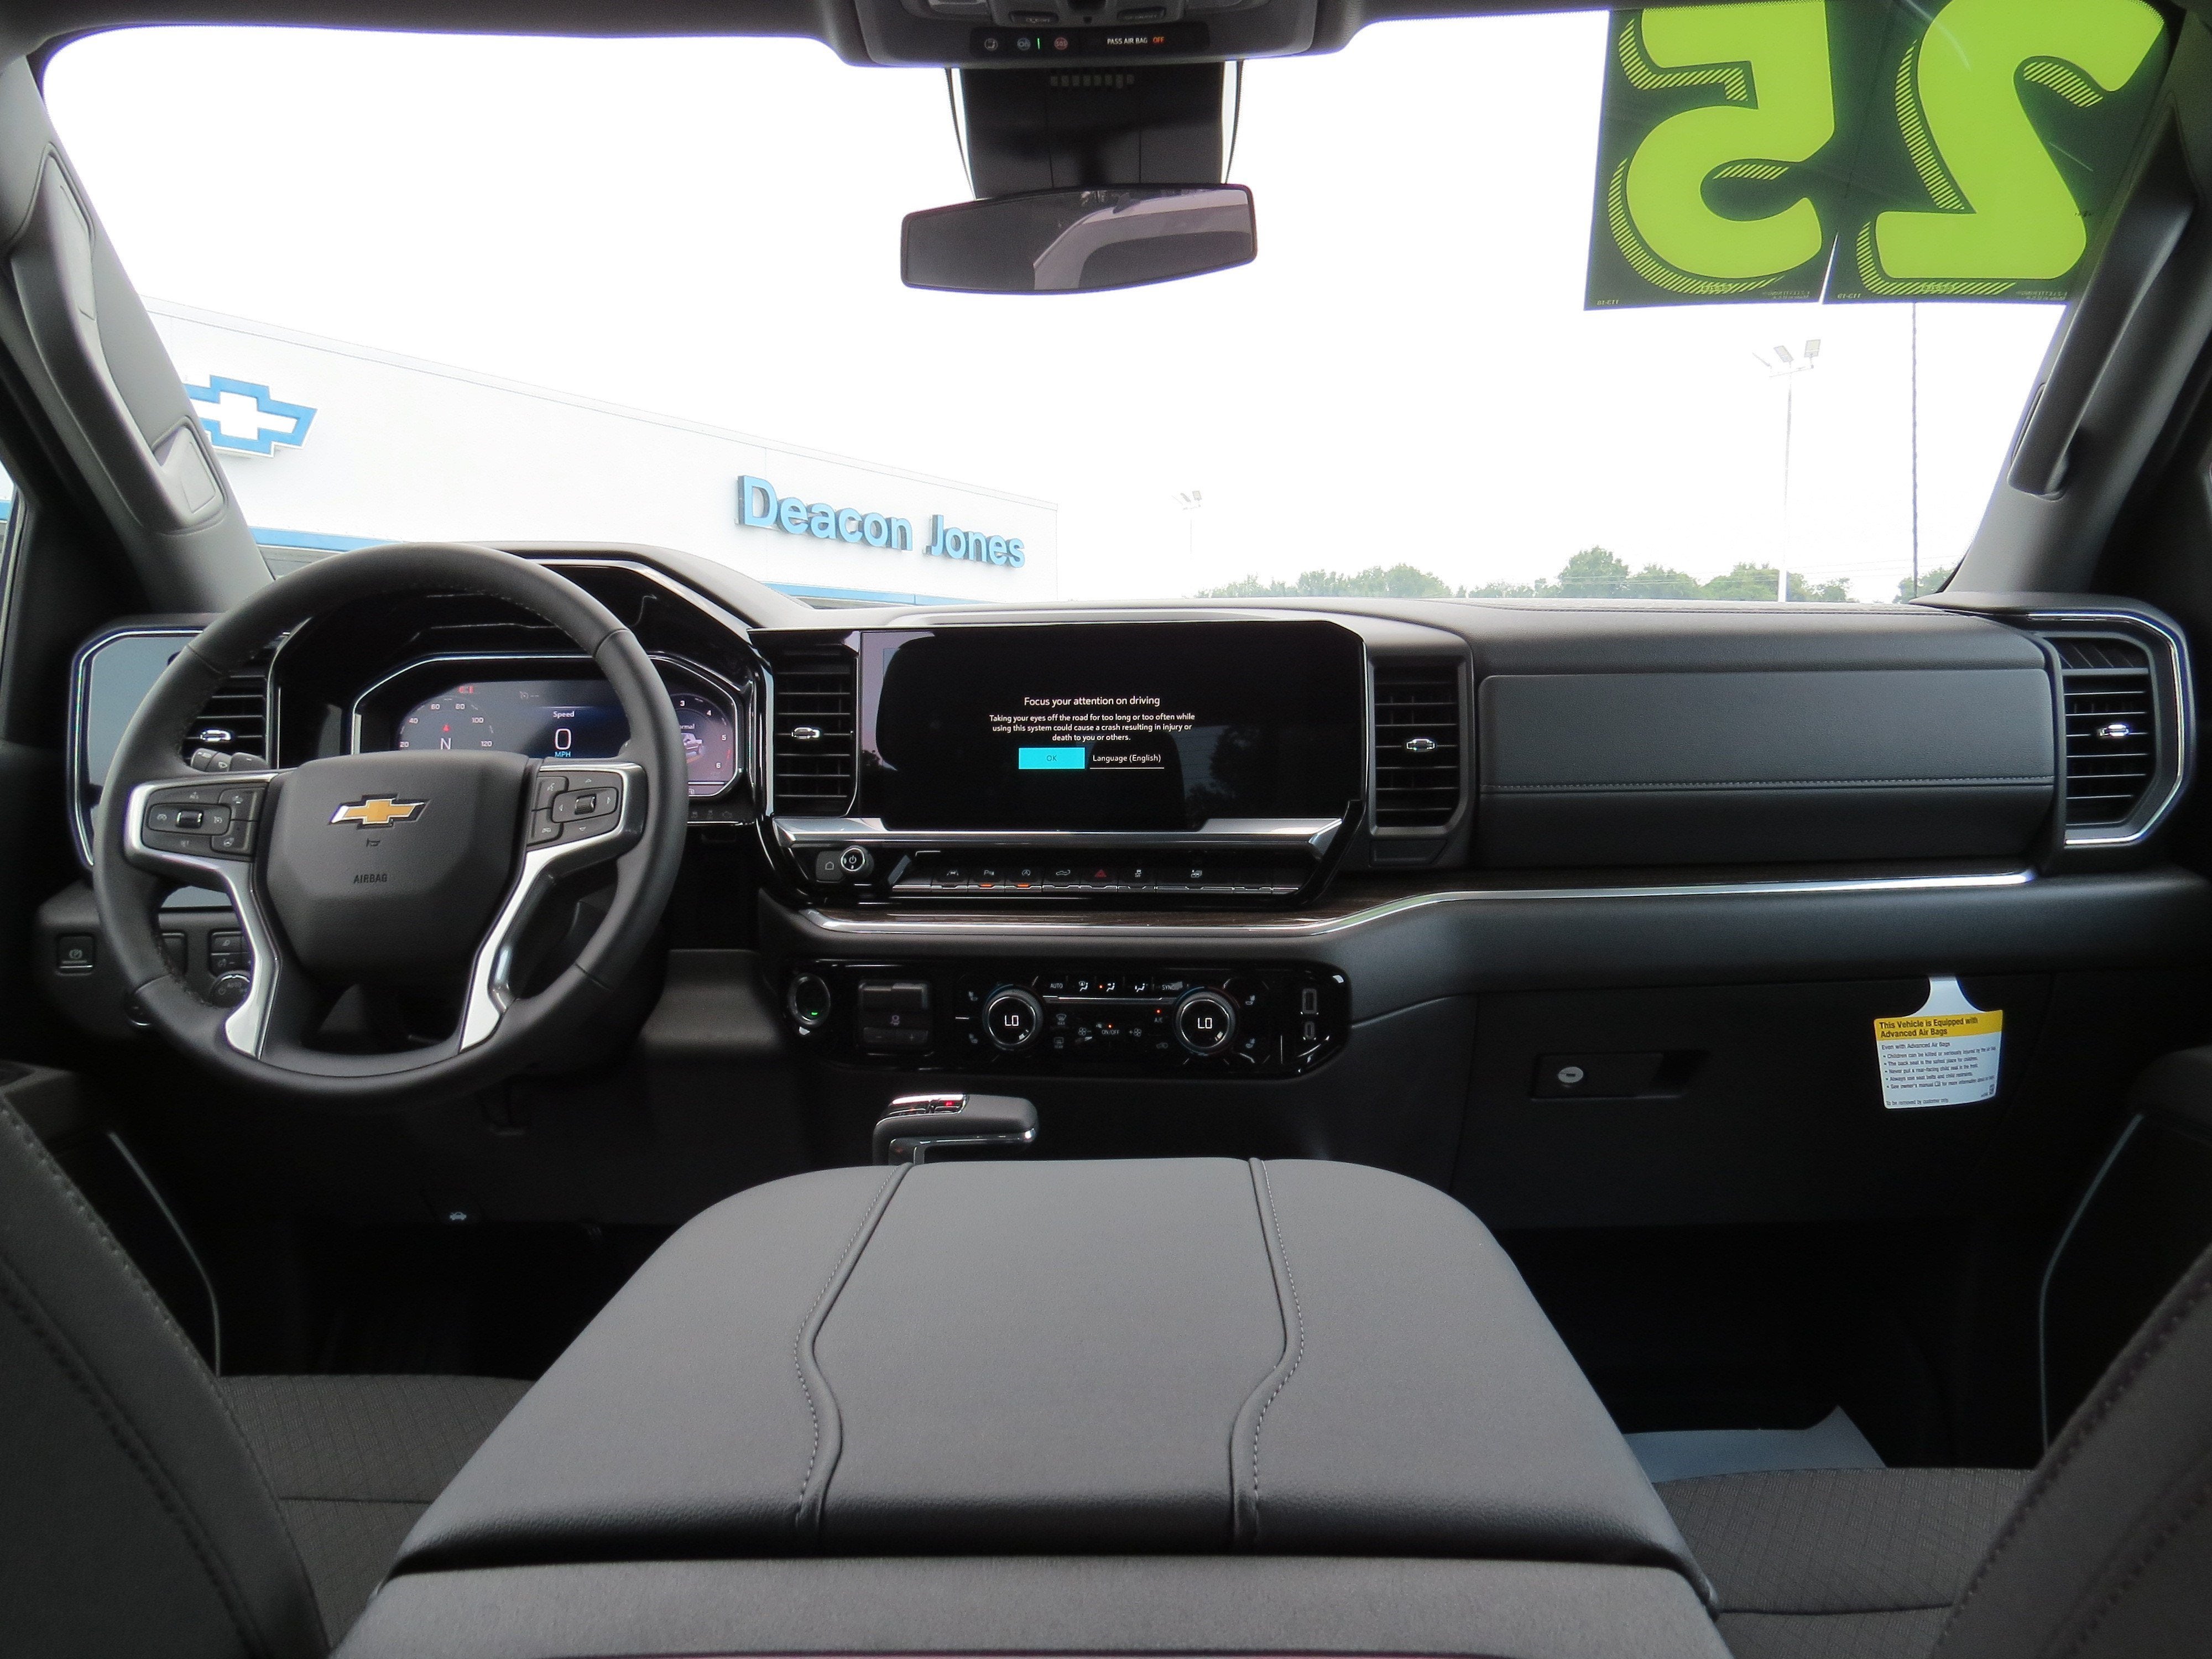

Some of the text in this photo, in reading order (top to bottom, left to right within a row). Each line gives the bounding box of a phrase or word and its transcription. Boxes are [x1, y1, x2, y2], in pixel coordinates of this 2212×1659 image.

[738, 475, 1025, 568] Deacon Jones
[1024, 697, 1050, 706] Focus
[1052, 698, 1072, 708] your
[1073, 697, 1114, 705] attention
[1129, 696, 1160, 707] driving
[553, 710, 575, 718] Speed
[989, 714, 1012, 723] Taking
[1115, 714, 1131, 722] long
[1122, 723, 1153, 732] resulting
[440, 738, 451, 750] N
[555, 728, 571, 750] 0
[1093, 754, 1161, 763] Language (English)
[353, 874, 388, 884] AIRBAG
[1004, 1015, 1019, 1026] LO
[1197, 1018, 1212, 1029] LO
[1898, 1020, 1923, 1029] Vehicle
[1934, 1018, 1964, 1027] Equipped
[1881, 1030, 1917, 1038] Advanced
[1931, 1028, 1948, 1036] Bags
